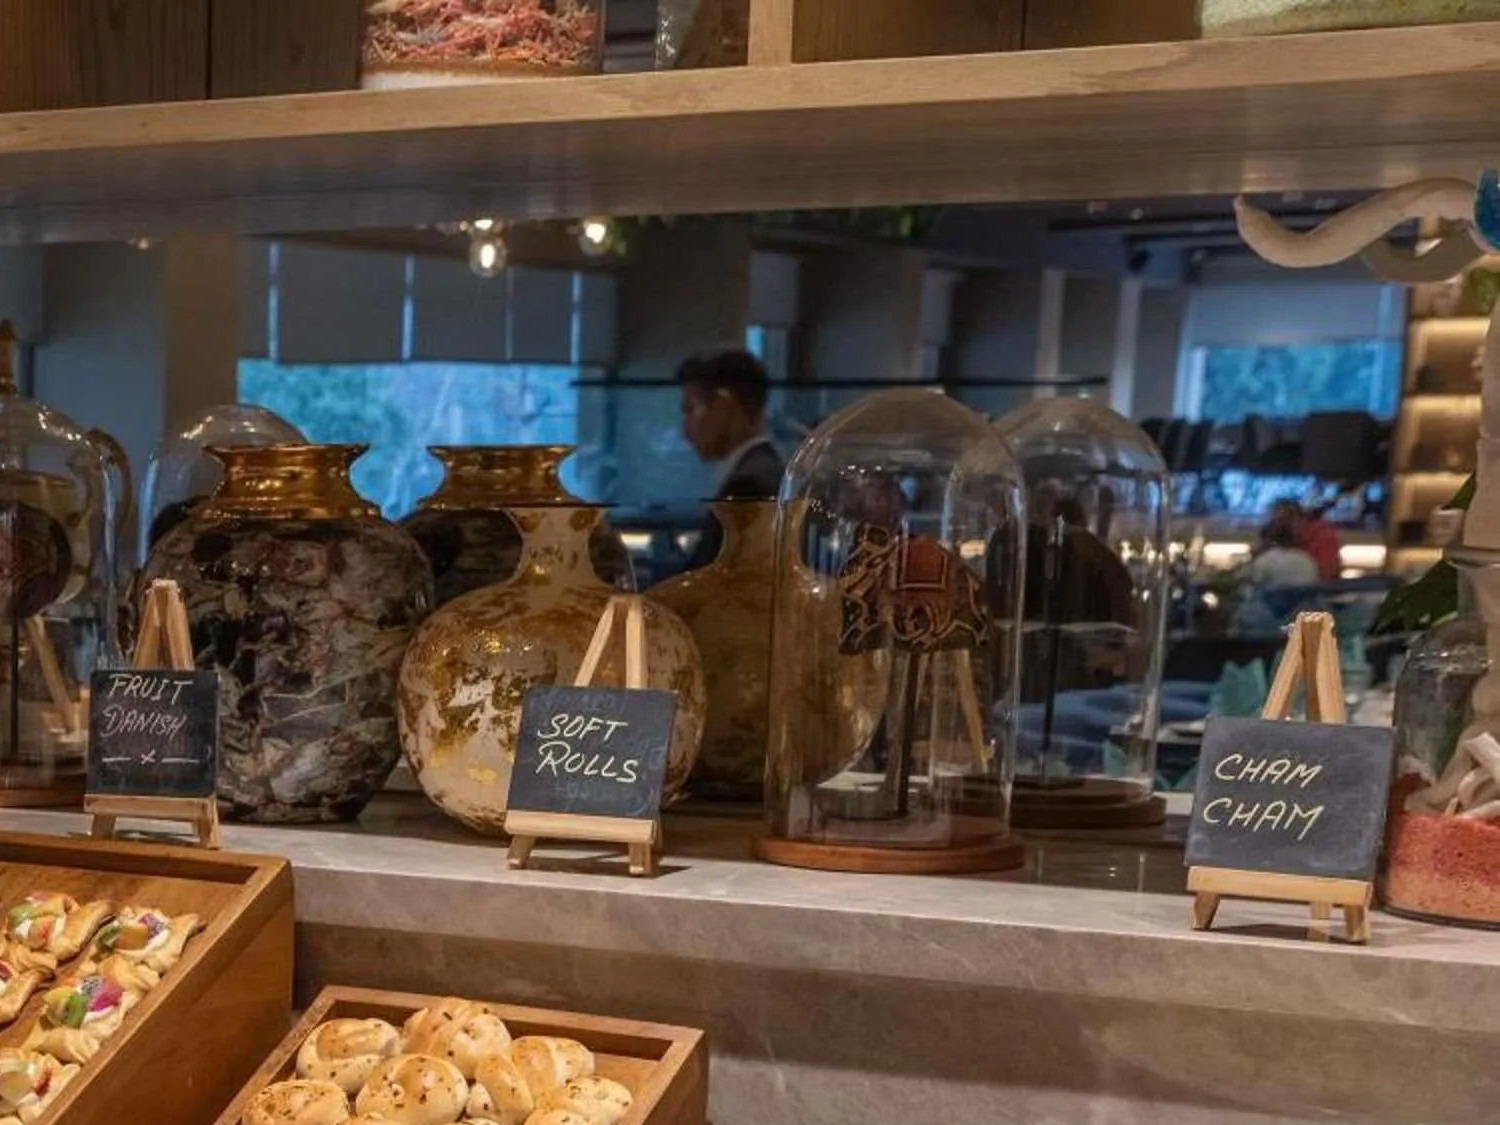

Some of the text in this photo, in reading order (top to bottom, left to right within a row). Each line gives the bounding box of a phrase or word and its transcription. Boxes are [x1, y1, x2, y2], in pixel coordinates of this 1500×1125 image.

[107, 672, 193, 705] FRUIT
[100, 703, 188, 740] DANISH
[536, 712, 629, 742] SOFT
[535, 741, 639, 784] ROLLS
[1214, 752, 1323, 788] CHAM
[1202, 796, 1326, 841] CHAM
